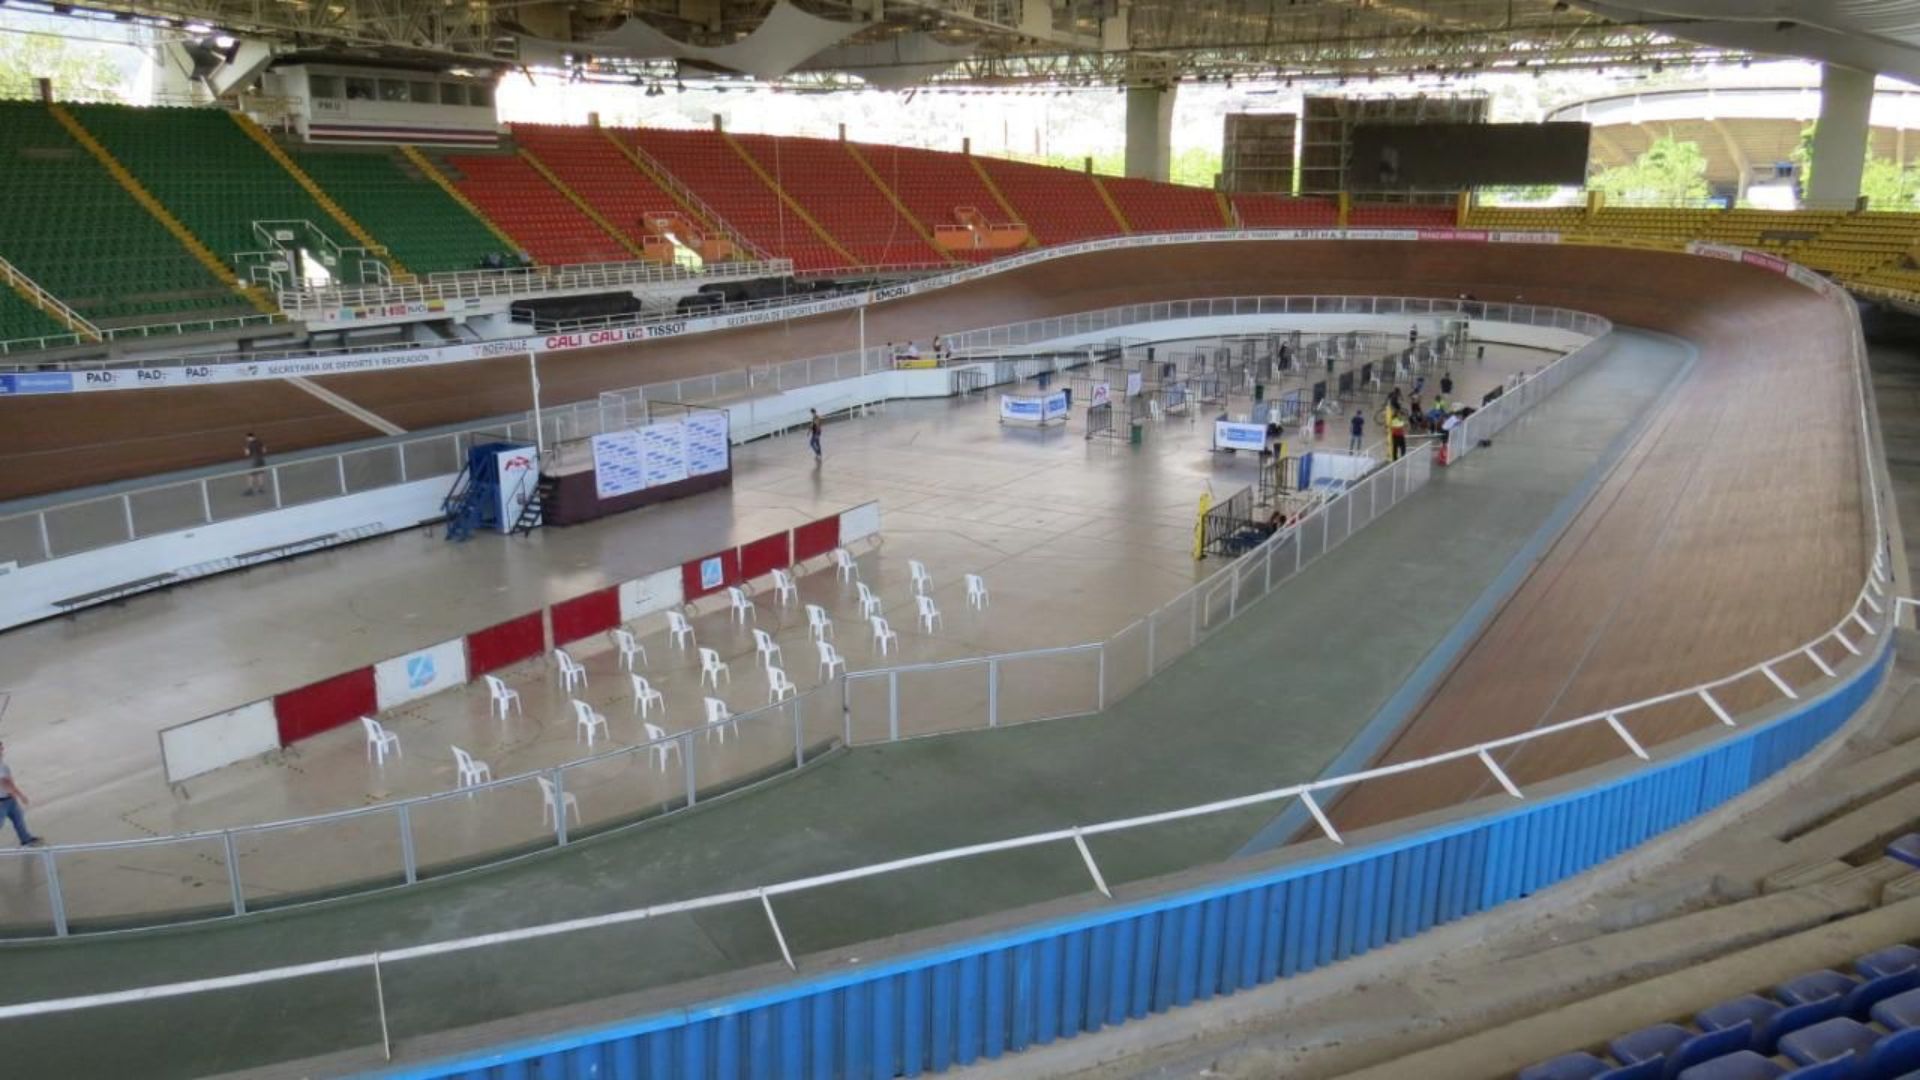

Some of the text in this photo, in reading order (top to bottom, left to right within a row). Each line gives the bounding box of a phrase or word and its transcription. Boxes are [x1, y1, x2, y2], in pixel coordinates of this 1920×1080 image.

[647, 321, 688, 337] TISSOT
[545, 330, 624, 350] CALI CALI
